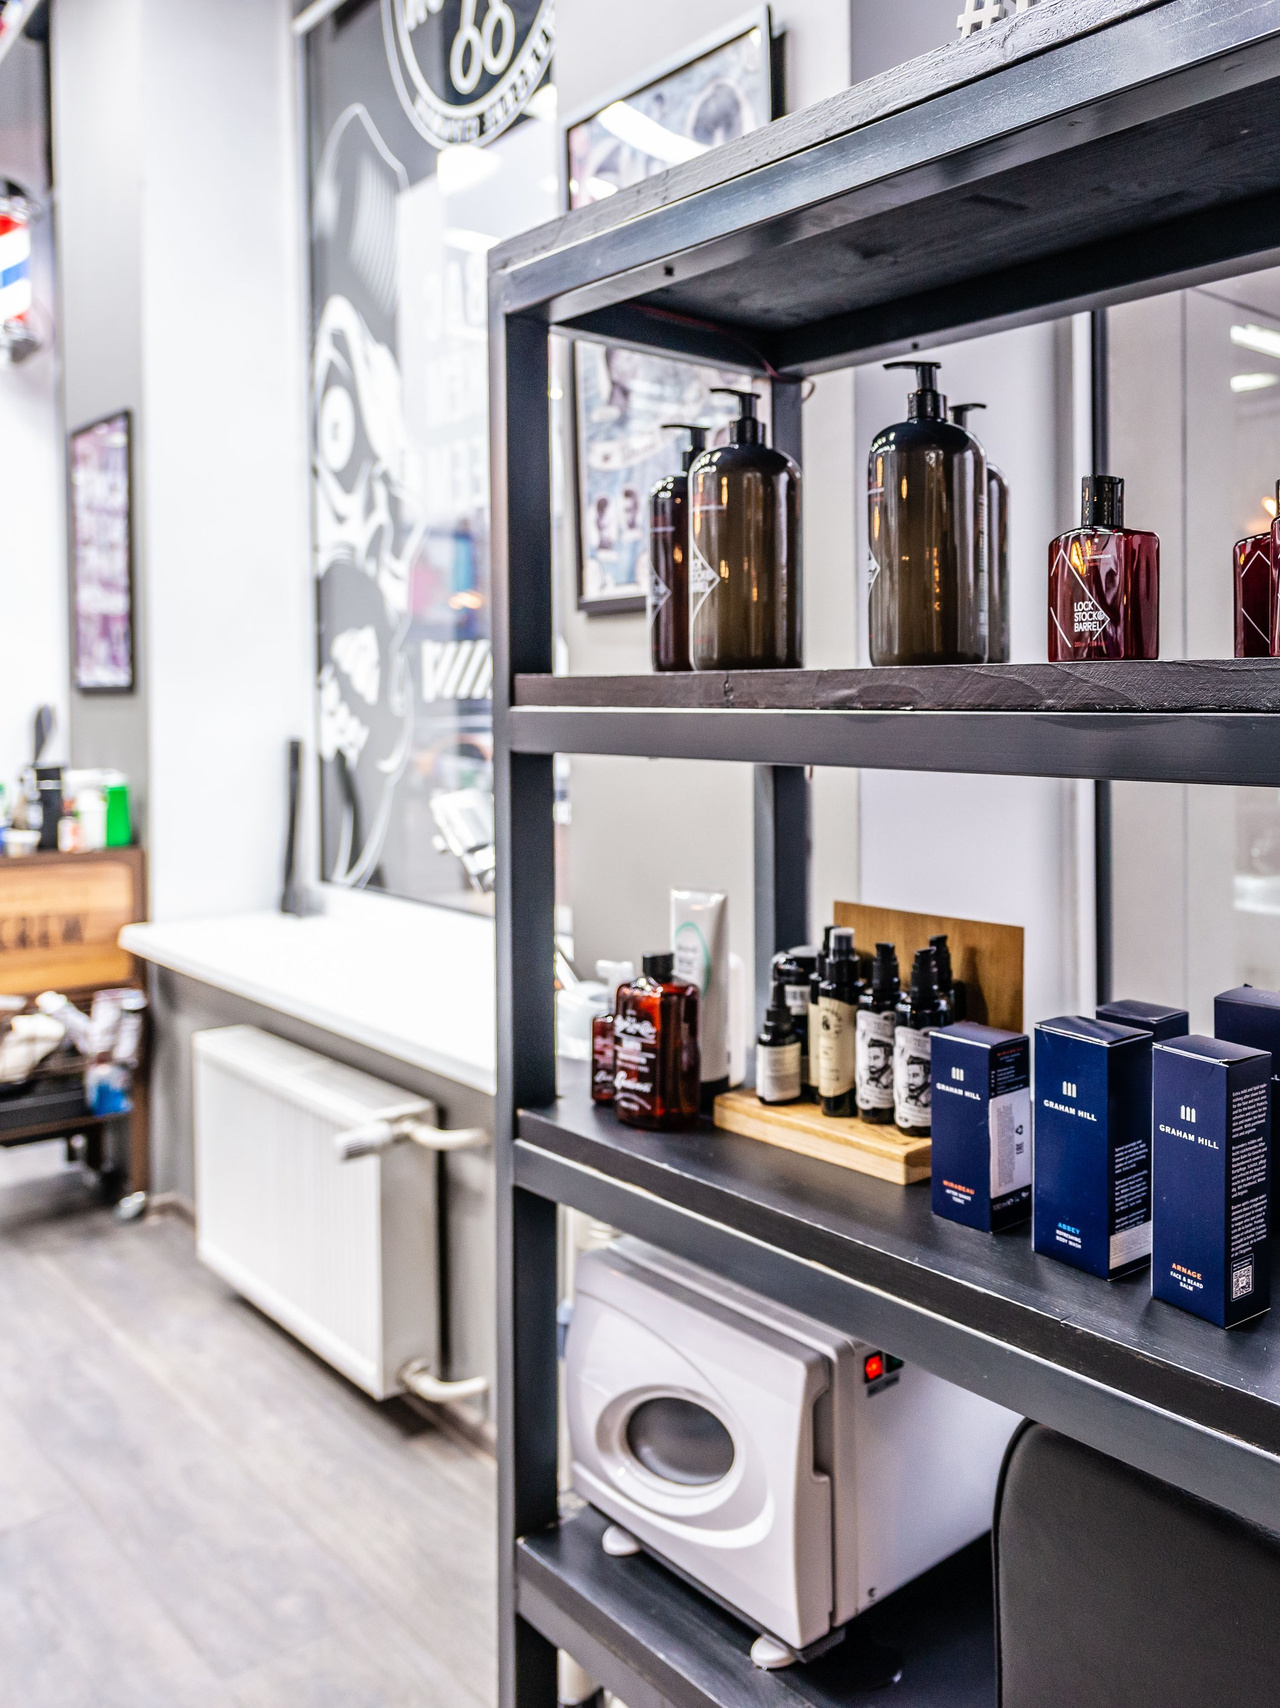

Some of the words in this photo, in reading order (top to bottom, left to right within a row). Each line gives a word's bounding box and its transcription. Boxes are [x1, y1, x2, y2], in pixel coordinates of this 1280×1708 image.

[1073, 600, 1094, 612] LOCK
[1073, 621, 1101, 632] BARREL
[935, 1082, 964, 1096] GRAHAM
[963, 1090, 981, 1101] HILL
[1043, 1099, 1076, 1116] GRAHAM
[1077, 1109, 1098, 1122] HILL
[1159, 1123, 1195, 1142] GRAHAM
[1197, 1136, 1220, 1150] HILL
[1057, 1221, 1081, 1235] ABBEY
[1170, 1270, 1182, 1281] FACE
[1187, 1278, 1204, 1290] BEARD
[1171, 1262, 1202, 1281] ARNAGE
